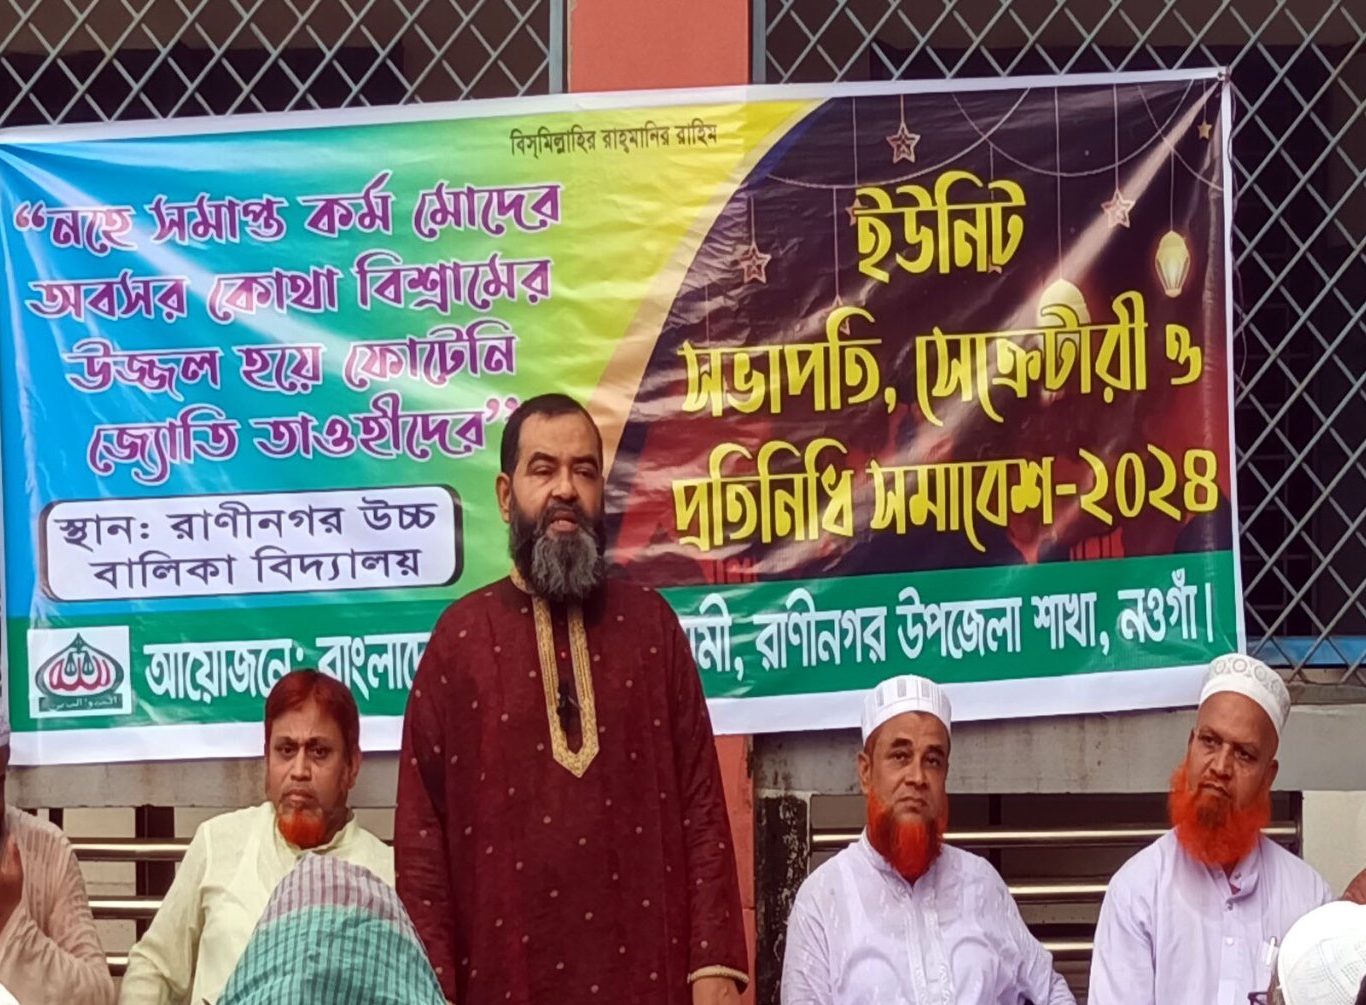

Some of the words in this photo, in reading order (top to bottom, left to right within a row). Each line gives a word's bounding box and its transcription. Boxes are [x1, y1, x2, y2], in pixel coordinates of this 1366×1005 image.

[674, 117, 718, 147] রাহিম
[16, 203, 131, 252] “নহে
[154, 197, 285, 242] সমাপ্ত
[307, 172, 393, 234] কর্ম
[417, 182, 560, 238] মোদের
[855, 170, 1025, 282] ইউনিট
[31, 274, 187, 318] অবসর
[210, 268, 337, 320] কোথা
[357, 252, 550, 312] বিশ্রামের
[237, 346, 324, 393] হয়ে
[345, 322, 517, 388] ফোটেনি
[680, 306, 896, 418] সভাপতি,
[915, 290, 1148, 427] সেক্রেটারী
[1165, 323, 1203, 386] ও
[89, 406, 239, 484] জ্যোতি
[165, 500, 344, 542] রাণীনগর
[360, 497, 439, 532] উচ্চ
[672, 440, 854, 552] প্রতিনিধি
[867, 447, 1219, 553] সমাবেশ-২০২৪
[88, 550, 238, 590] বালিকা
[254, 544, 422, 583] বিদ্যালয়
[753, 587, 887, 671] রাণীনগর
[896, 586, 1023, 660] উপজেলা
[1031, 590, 1110, 656] শাখা,
